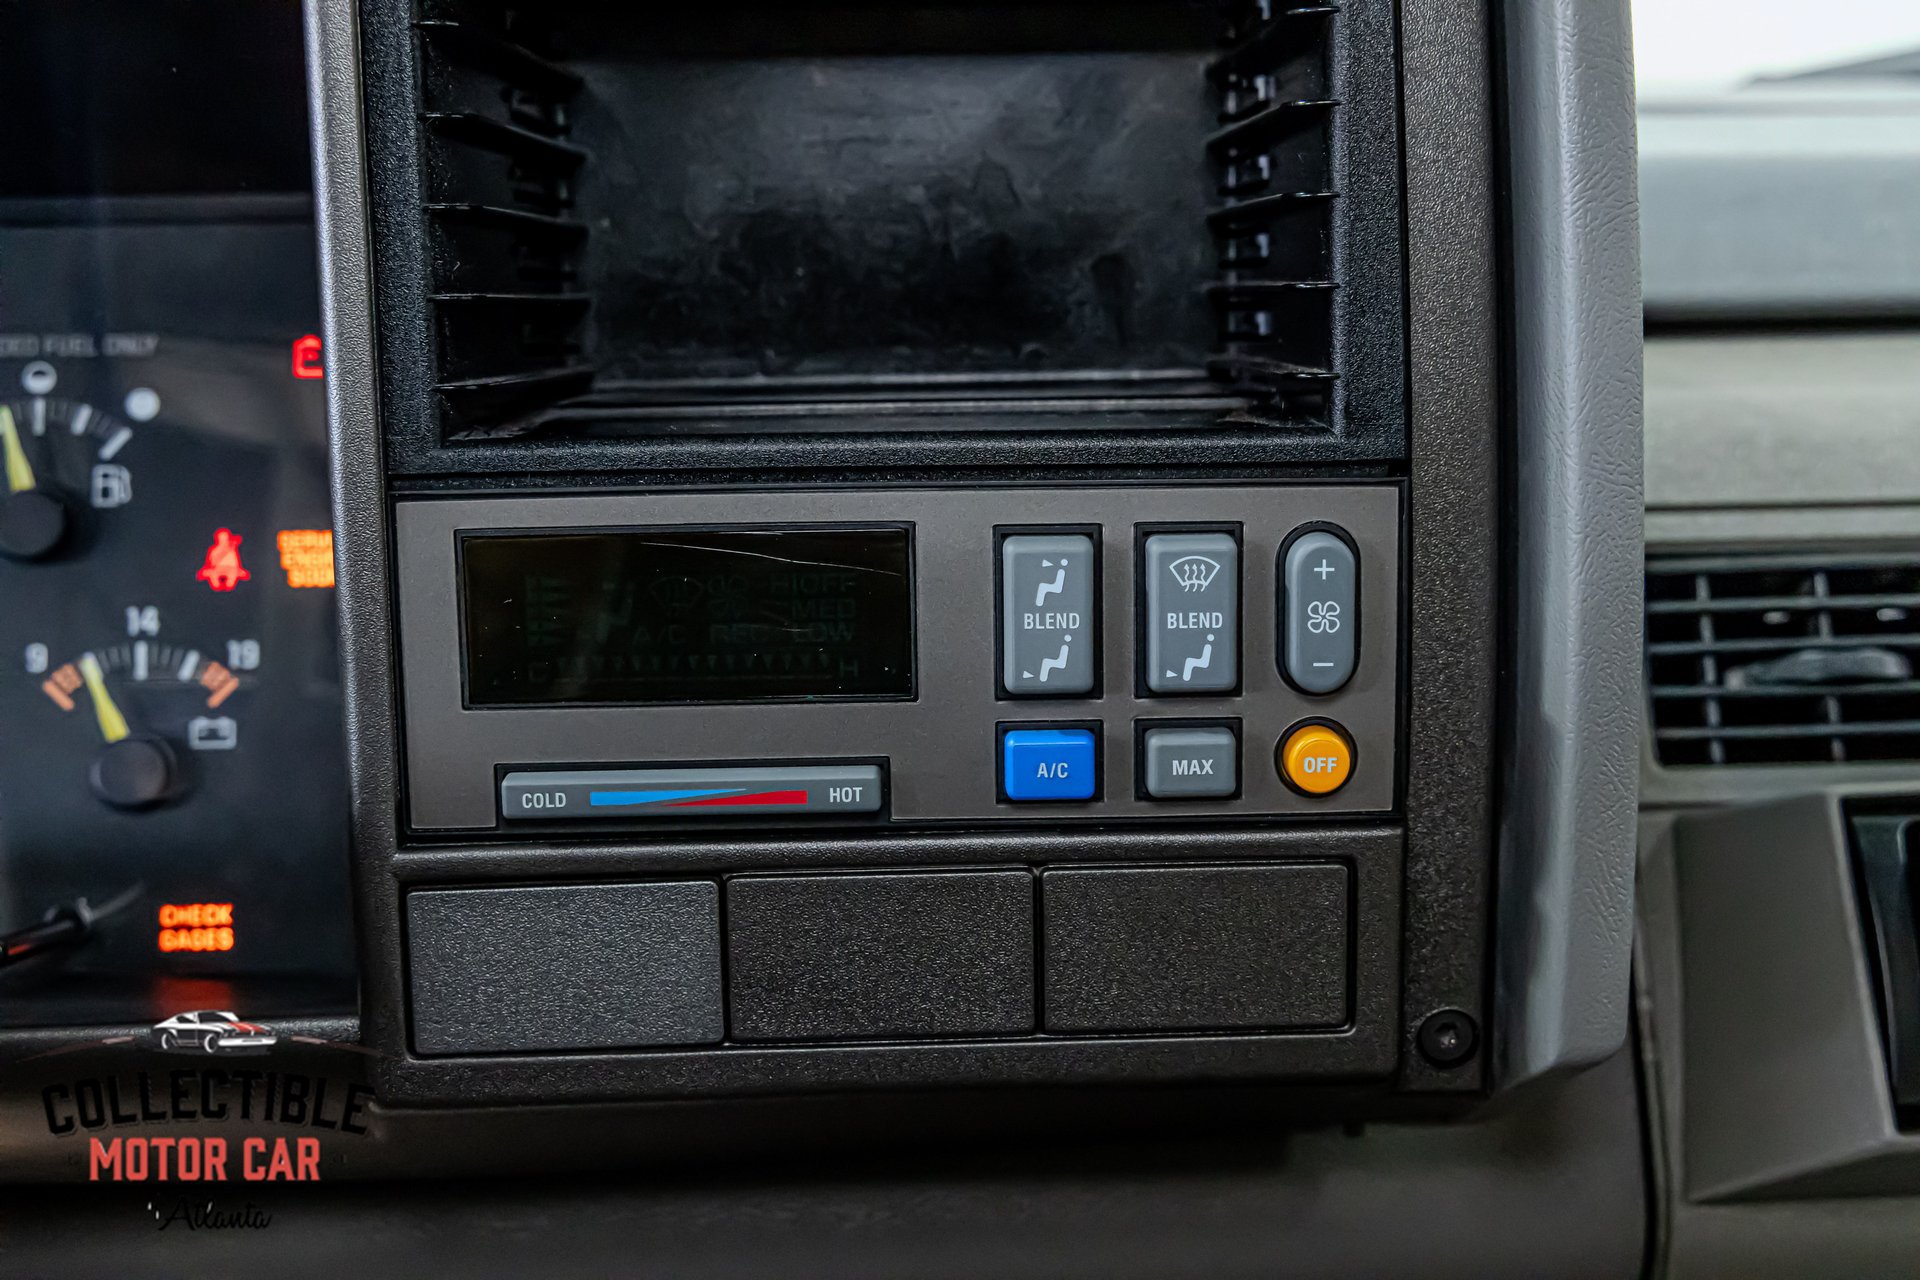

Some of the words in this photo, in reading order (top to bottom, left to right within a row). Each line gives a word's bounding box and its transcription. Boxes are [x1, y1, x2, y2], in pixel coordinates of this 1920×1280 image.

[126, 606, 160, 636] 14
[1023, 612, 1080, 630] BLEND
[1167, 612, 1223, 629] BLEND
[25, 643, 48, 673] 9
[227, 639, 260, 670] 19
[1037, 762, 1069, 779] A/C
[1172, 758, 1214, 776] MAX
[1303, 756, 1338, 774] OFF
[521, 792, 567, 809] COLD
[829, 786, 863, 803] HOT
[159, 903, 234, 927] CHECK
